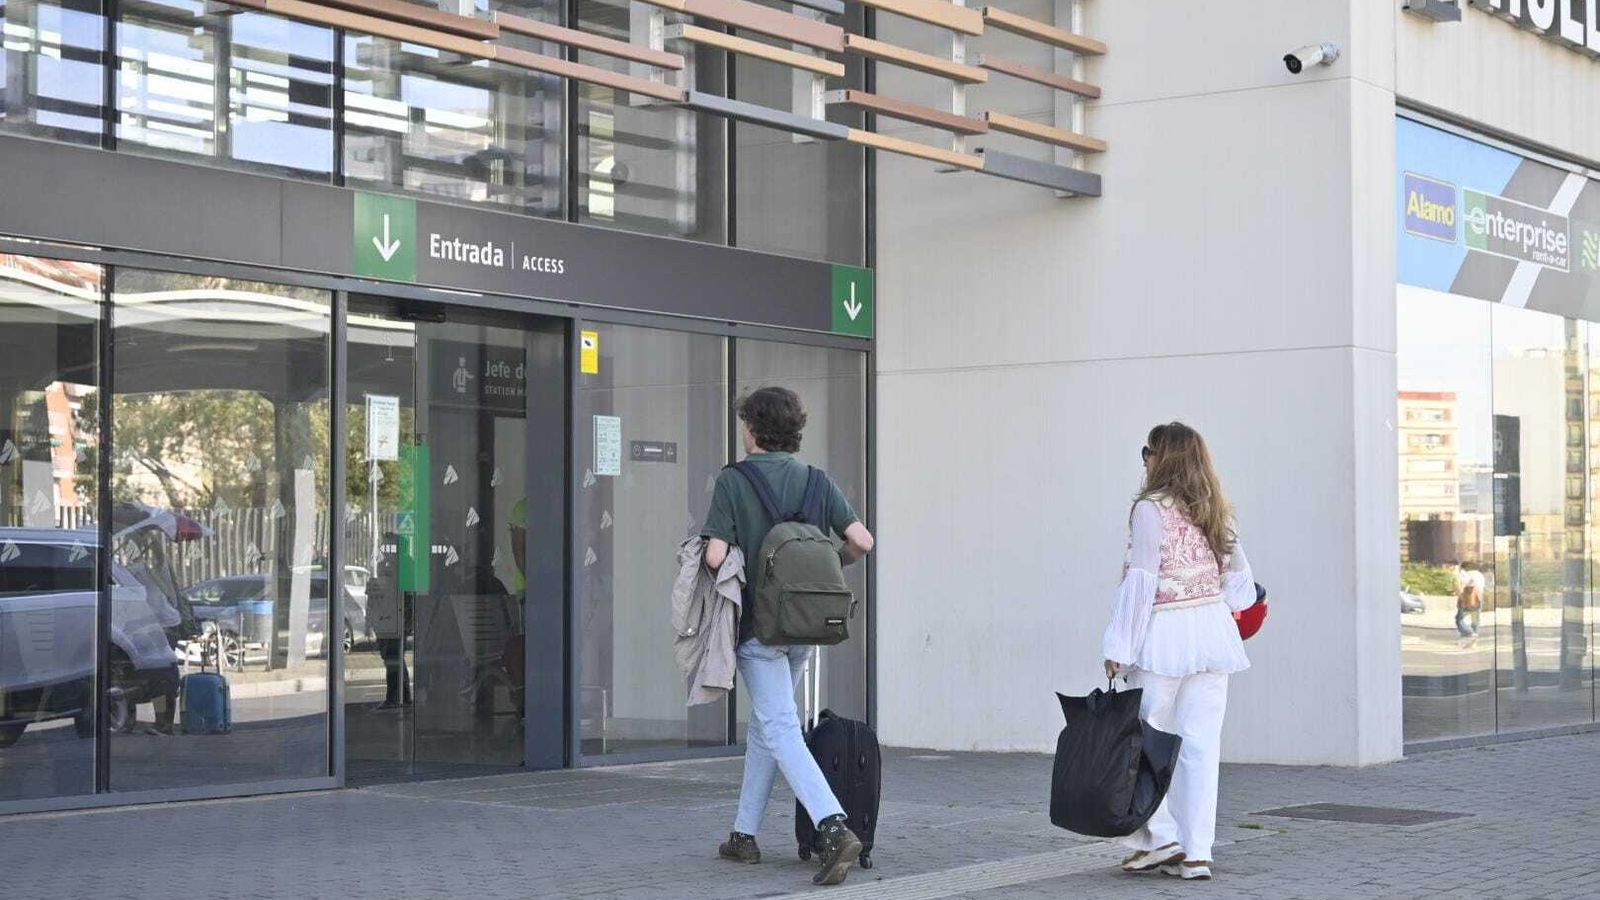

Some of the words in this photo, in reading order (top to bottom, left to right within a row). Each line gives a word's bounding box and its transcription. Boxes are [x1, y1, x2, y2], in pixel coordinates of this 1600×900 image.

[1407, 190, 1454, 227] Alamo
[1466, 206, 1567, 254] enterprise
[430, 232, 504, 267] Entrada
[522, 255, 565, 274] ACCESS
[1531, 250, 1566, 267] rent-a-car
[485, 360, 511, 379] Jefe
